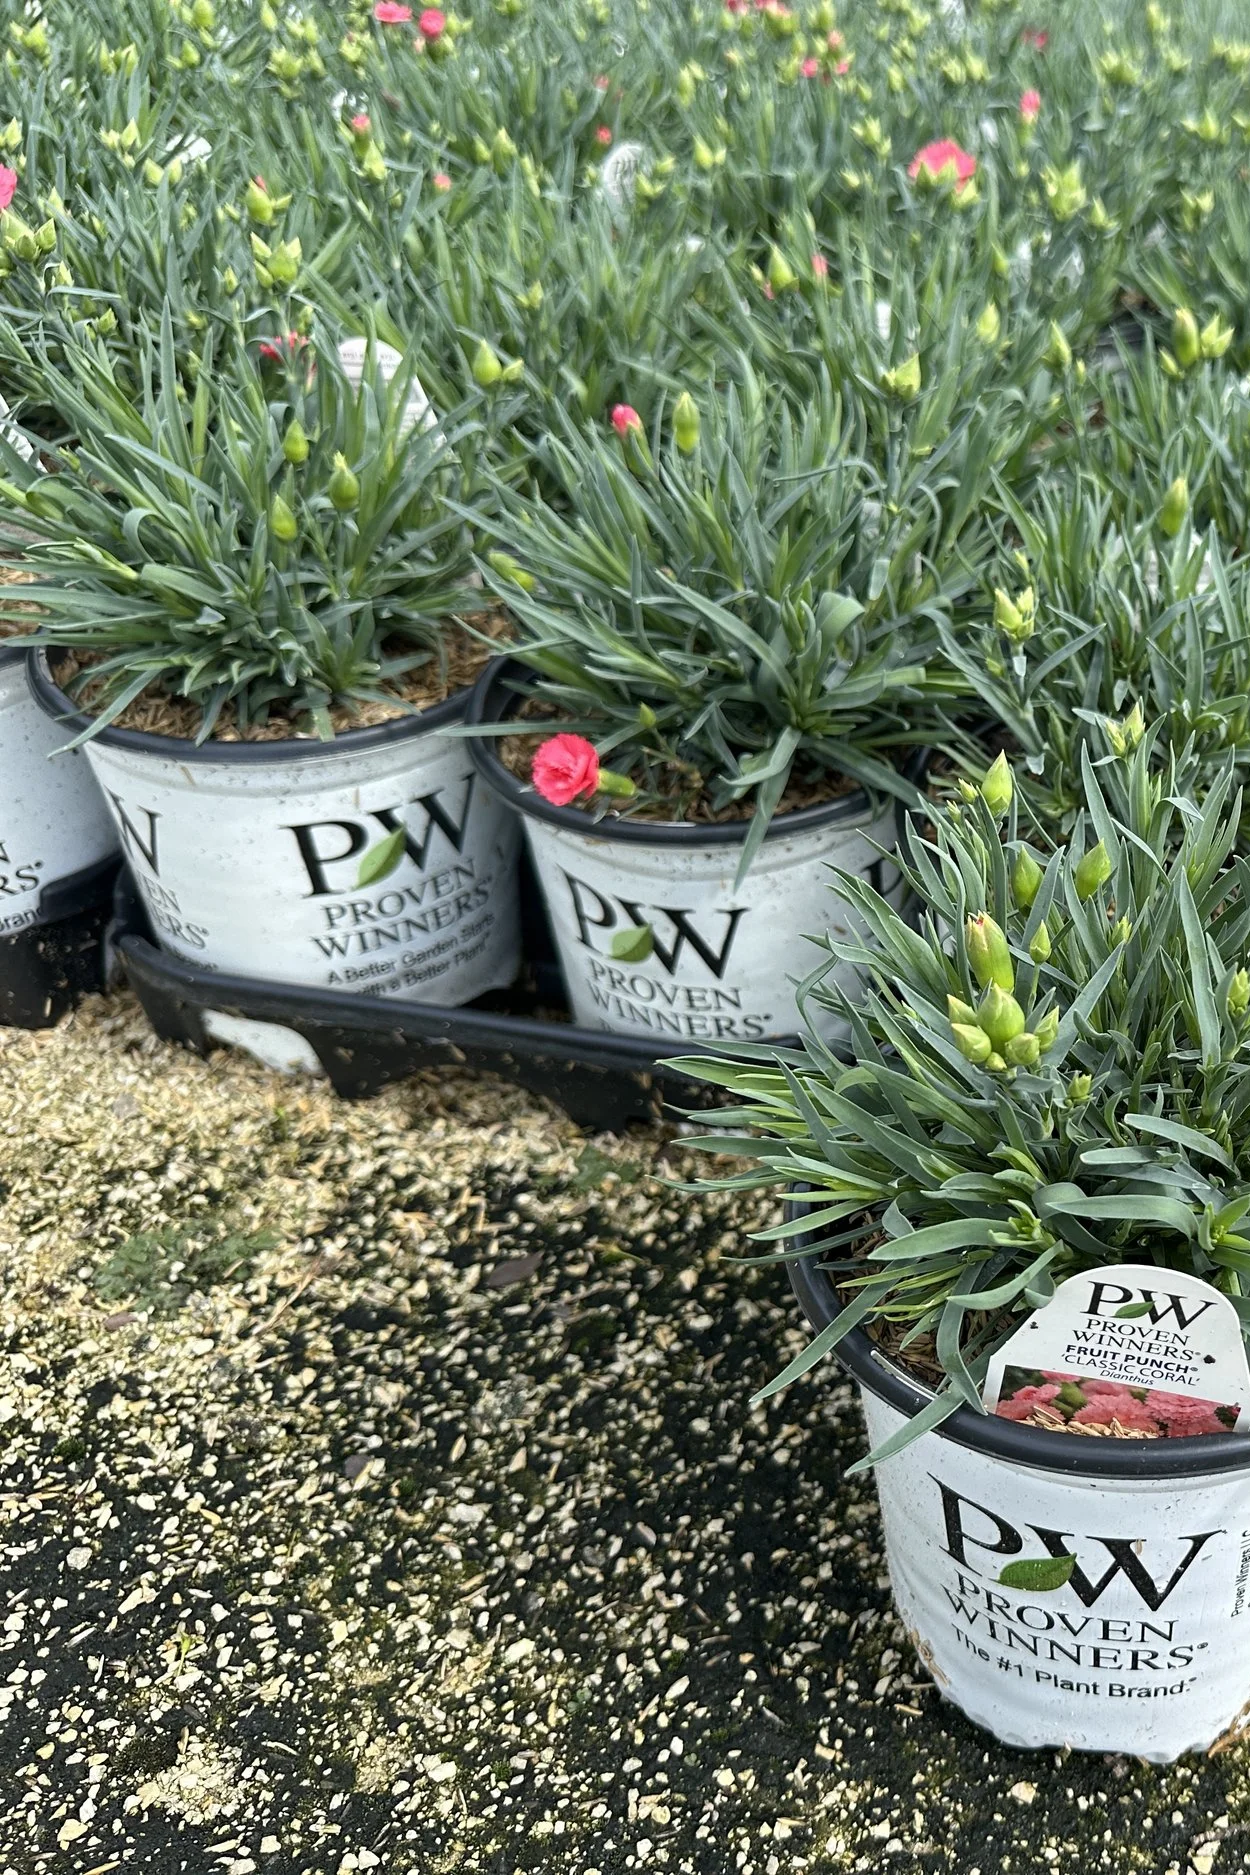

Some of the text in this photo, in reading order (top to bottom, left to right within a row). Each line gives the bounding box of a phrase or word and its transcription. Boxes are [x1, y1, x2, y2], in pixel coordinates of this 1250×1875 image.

[280, 773, 476, 898] PW
[321, 858, 476, 930] PROVEN
[556, 863, 752, 980] PW
[328, 969, 343, 986] A
[344, 958, 397, 983] Better
[402, 935, 458, 968] Garden
[390, 977, 401, 992] a
[403, 960, 450, 987] Better
[588, 956, 743, 1011] PROVEN
[1080, 1281, 1218, 1331] PW
[1086, 1318, 1191, 1346] PROVEN
[1066, 1344, 1120, 1361] FRUIT
[1100, 1369, 1154, 1386] Dianthus
[927, 1472, 1227, 1612] PW
[954, 1568, 1179, 1643] PROVEN
[1231, 1584, 1247, 1618] Proven
[951, 1622, 991, 1662] The
[996, 1656, 1024, 1677] #1
[1035, 1670, 1100, 1695] Plant
